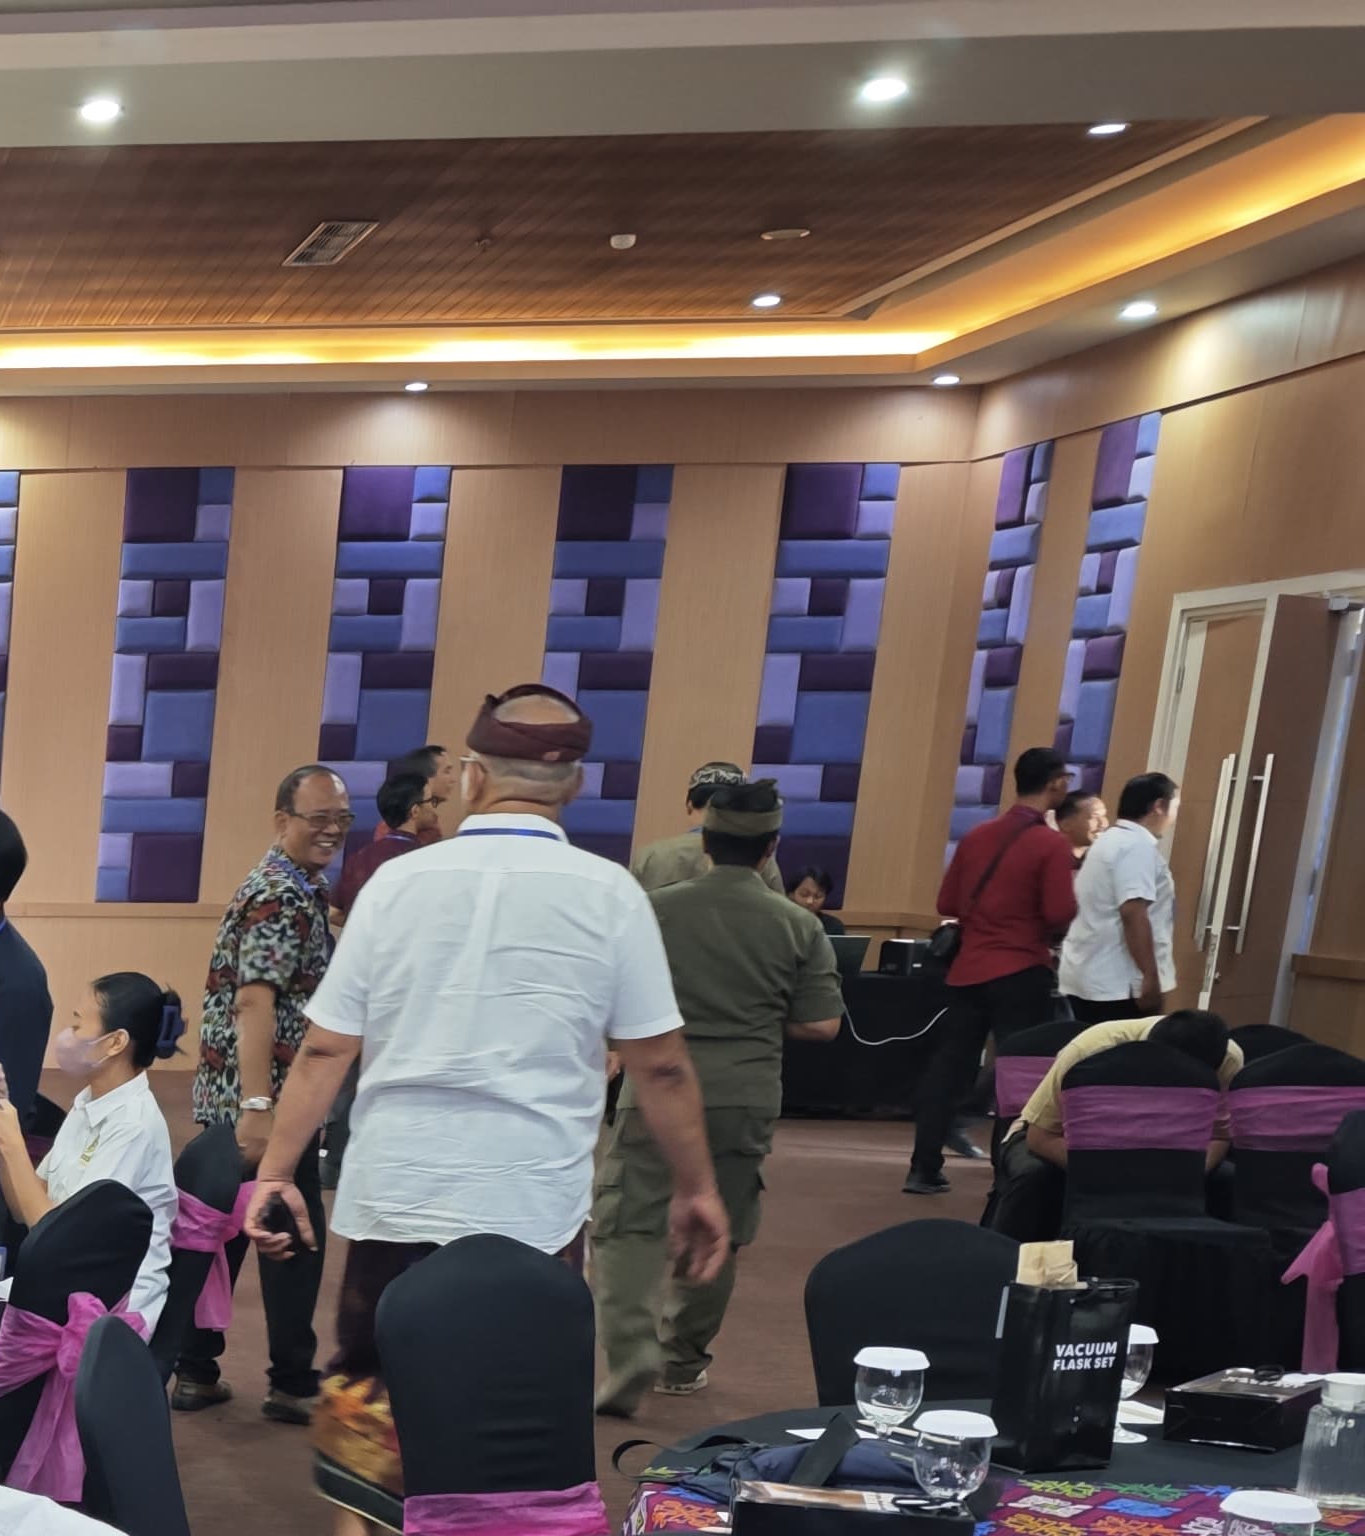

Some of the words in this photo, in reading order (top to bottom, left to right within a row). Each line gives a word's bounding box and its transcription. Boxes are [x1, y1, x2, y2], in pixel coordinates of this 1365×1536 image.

[1055, 1341, 1117, 1357] VACUUM
[1052, 1358, 1092, 1371] FLASK
[1093, 1356, 1115, 1369] SET
